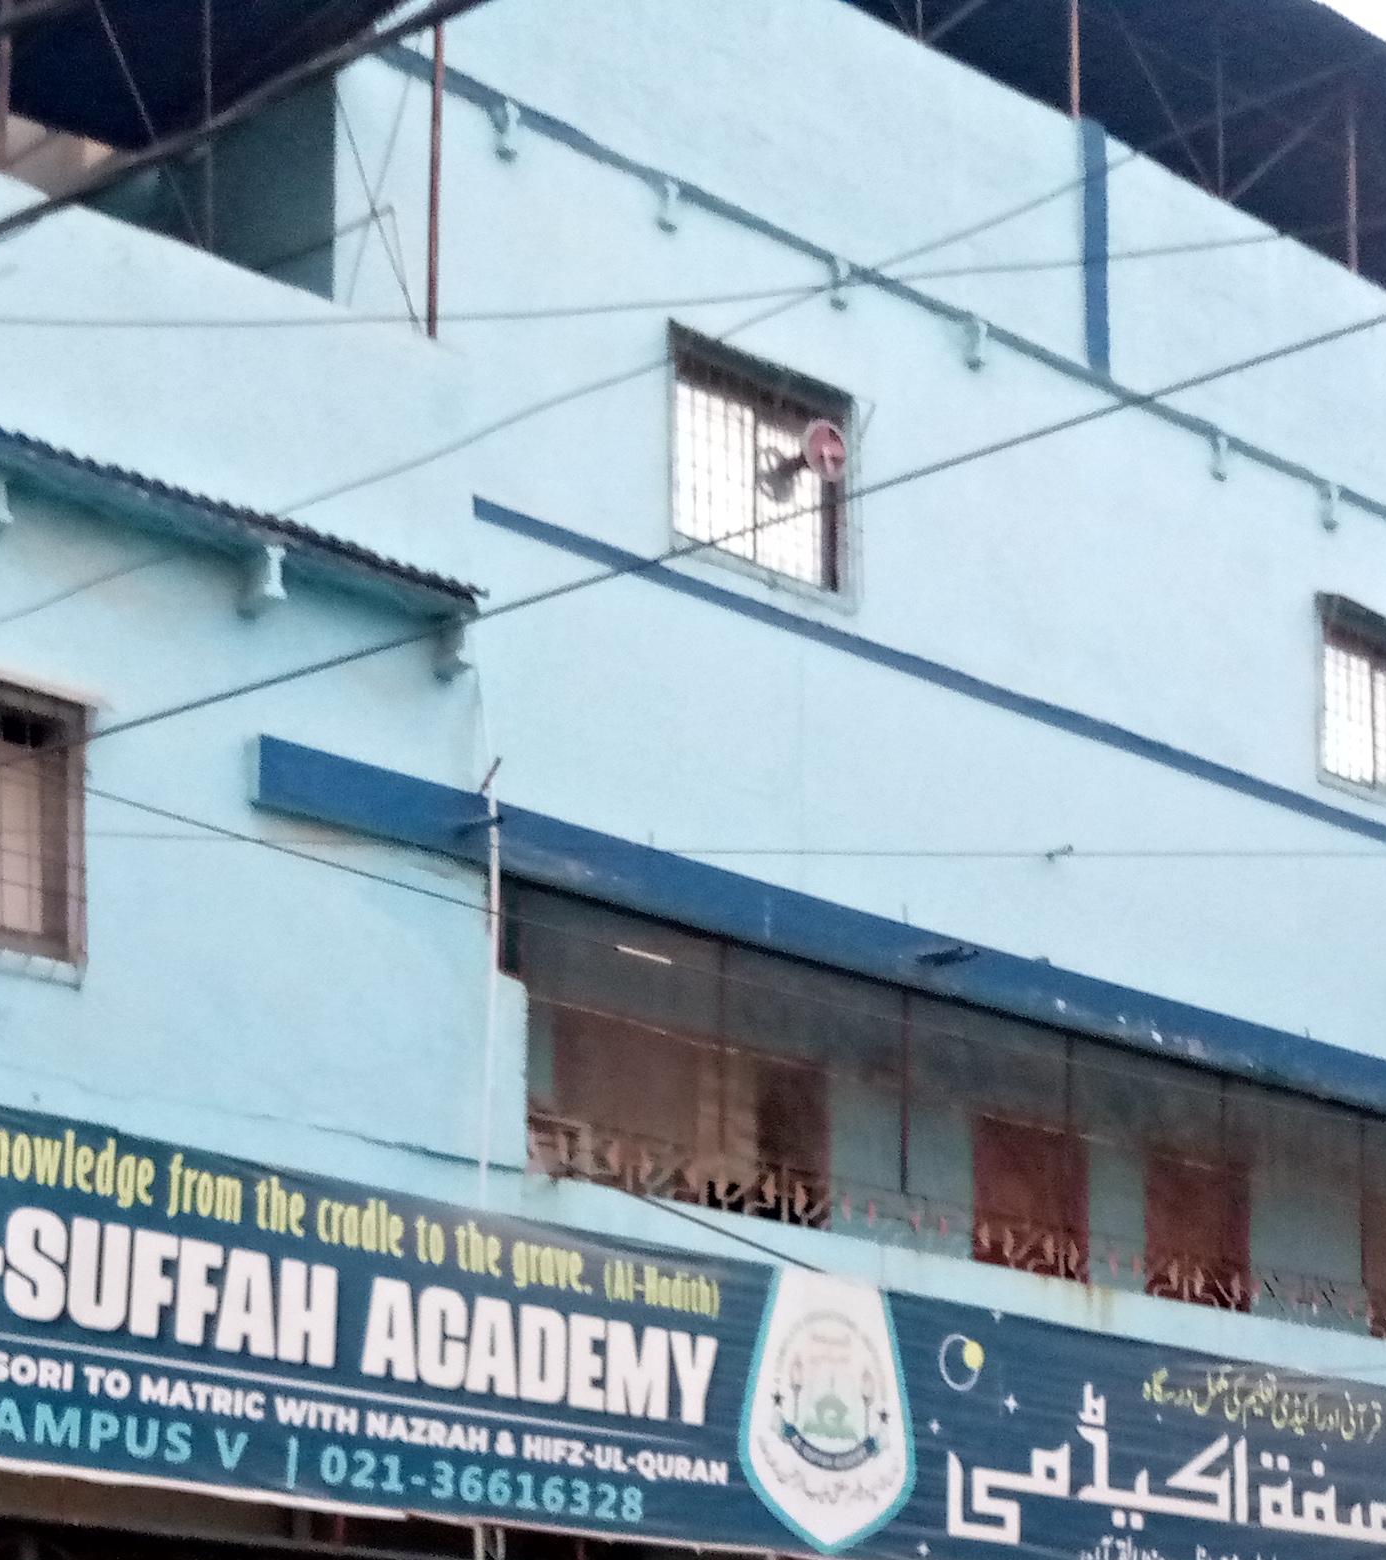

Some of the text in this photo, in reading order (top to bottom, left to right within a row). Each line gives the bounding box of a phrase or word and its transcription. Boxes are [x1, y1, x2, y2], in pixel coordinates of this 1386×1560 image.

[167, 1153, 243, 1224] from
[255, 1175, 306, 1238] the
[317, 1198, 404, 1258] cradle
[416, 1214, 446, 1266] to
[455, 1219, 502, 1277] the
[512, 1240, 593, 1295] grave.
[361, 1275, 718, 1427] ACADEMY
[83, 1364, 132, 1400] TO
[139, 1374, 265, 1422] MATRIC
[274, 1394, 359, 1436] WITH
[366, 1410, 489, 1454] NAZRAH
[494, 1430, 515, 1457] &
[523, 1433, 729, 1487] HIFZ-UL-QURAN
[215, 1428, 250, 1471] V
[319, 1443, 644, 1524] 021-36616328
